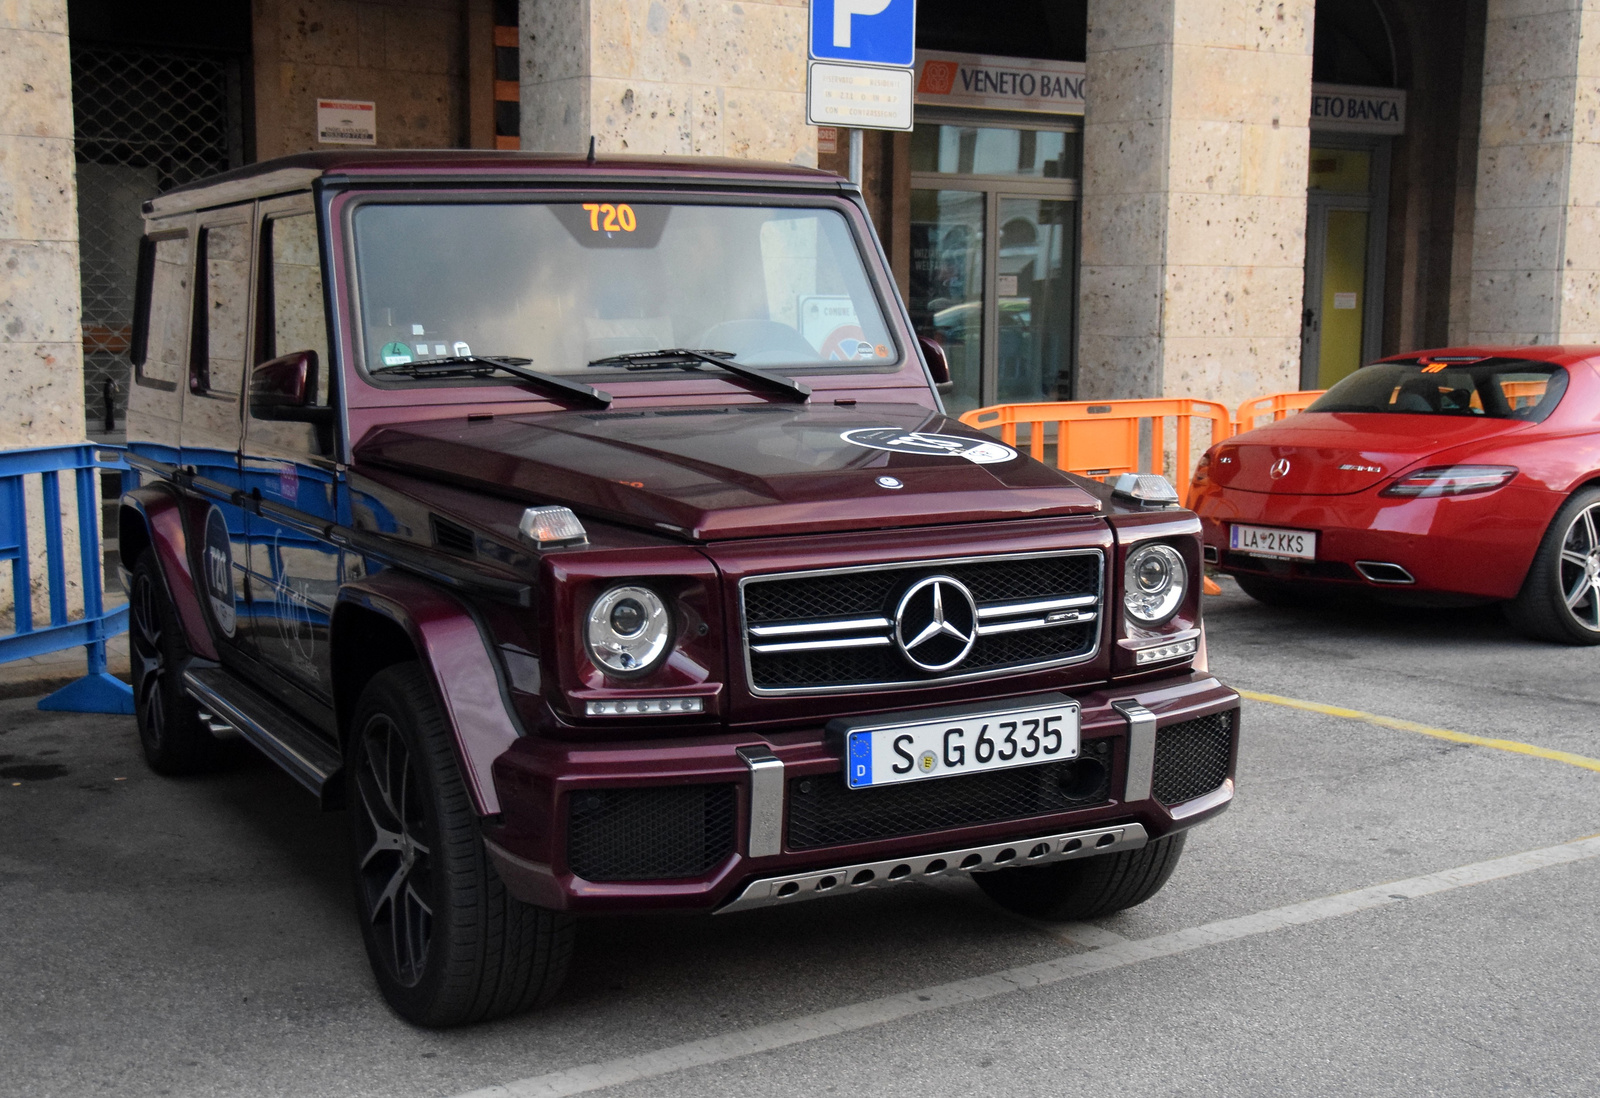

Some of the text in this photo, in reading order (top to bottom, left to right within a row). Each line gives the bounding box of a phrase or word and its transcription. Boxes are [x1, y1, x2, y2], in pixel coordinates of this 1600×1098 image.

[960, 67, 1036, 96] VENETO
[1347, 99, 1399, 121] BANCA
[582, 203, 637, 231] 720
[392, 343, 401, 356] 4
[1244, 530, 1259, 549] LA
[892, 715, 1063, 774] S G 6335
[856, 764, 866, 777] D
